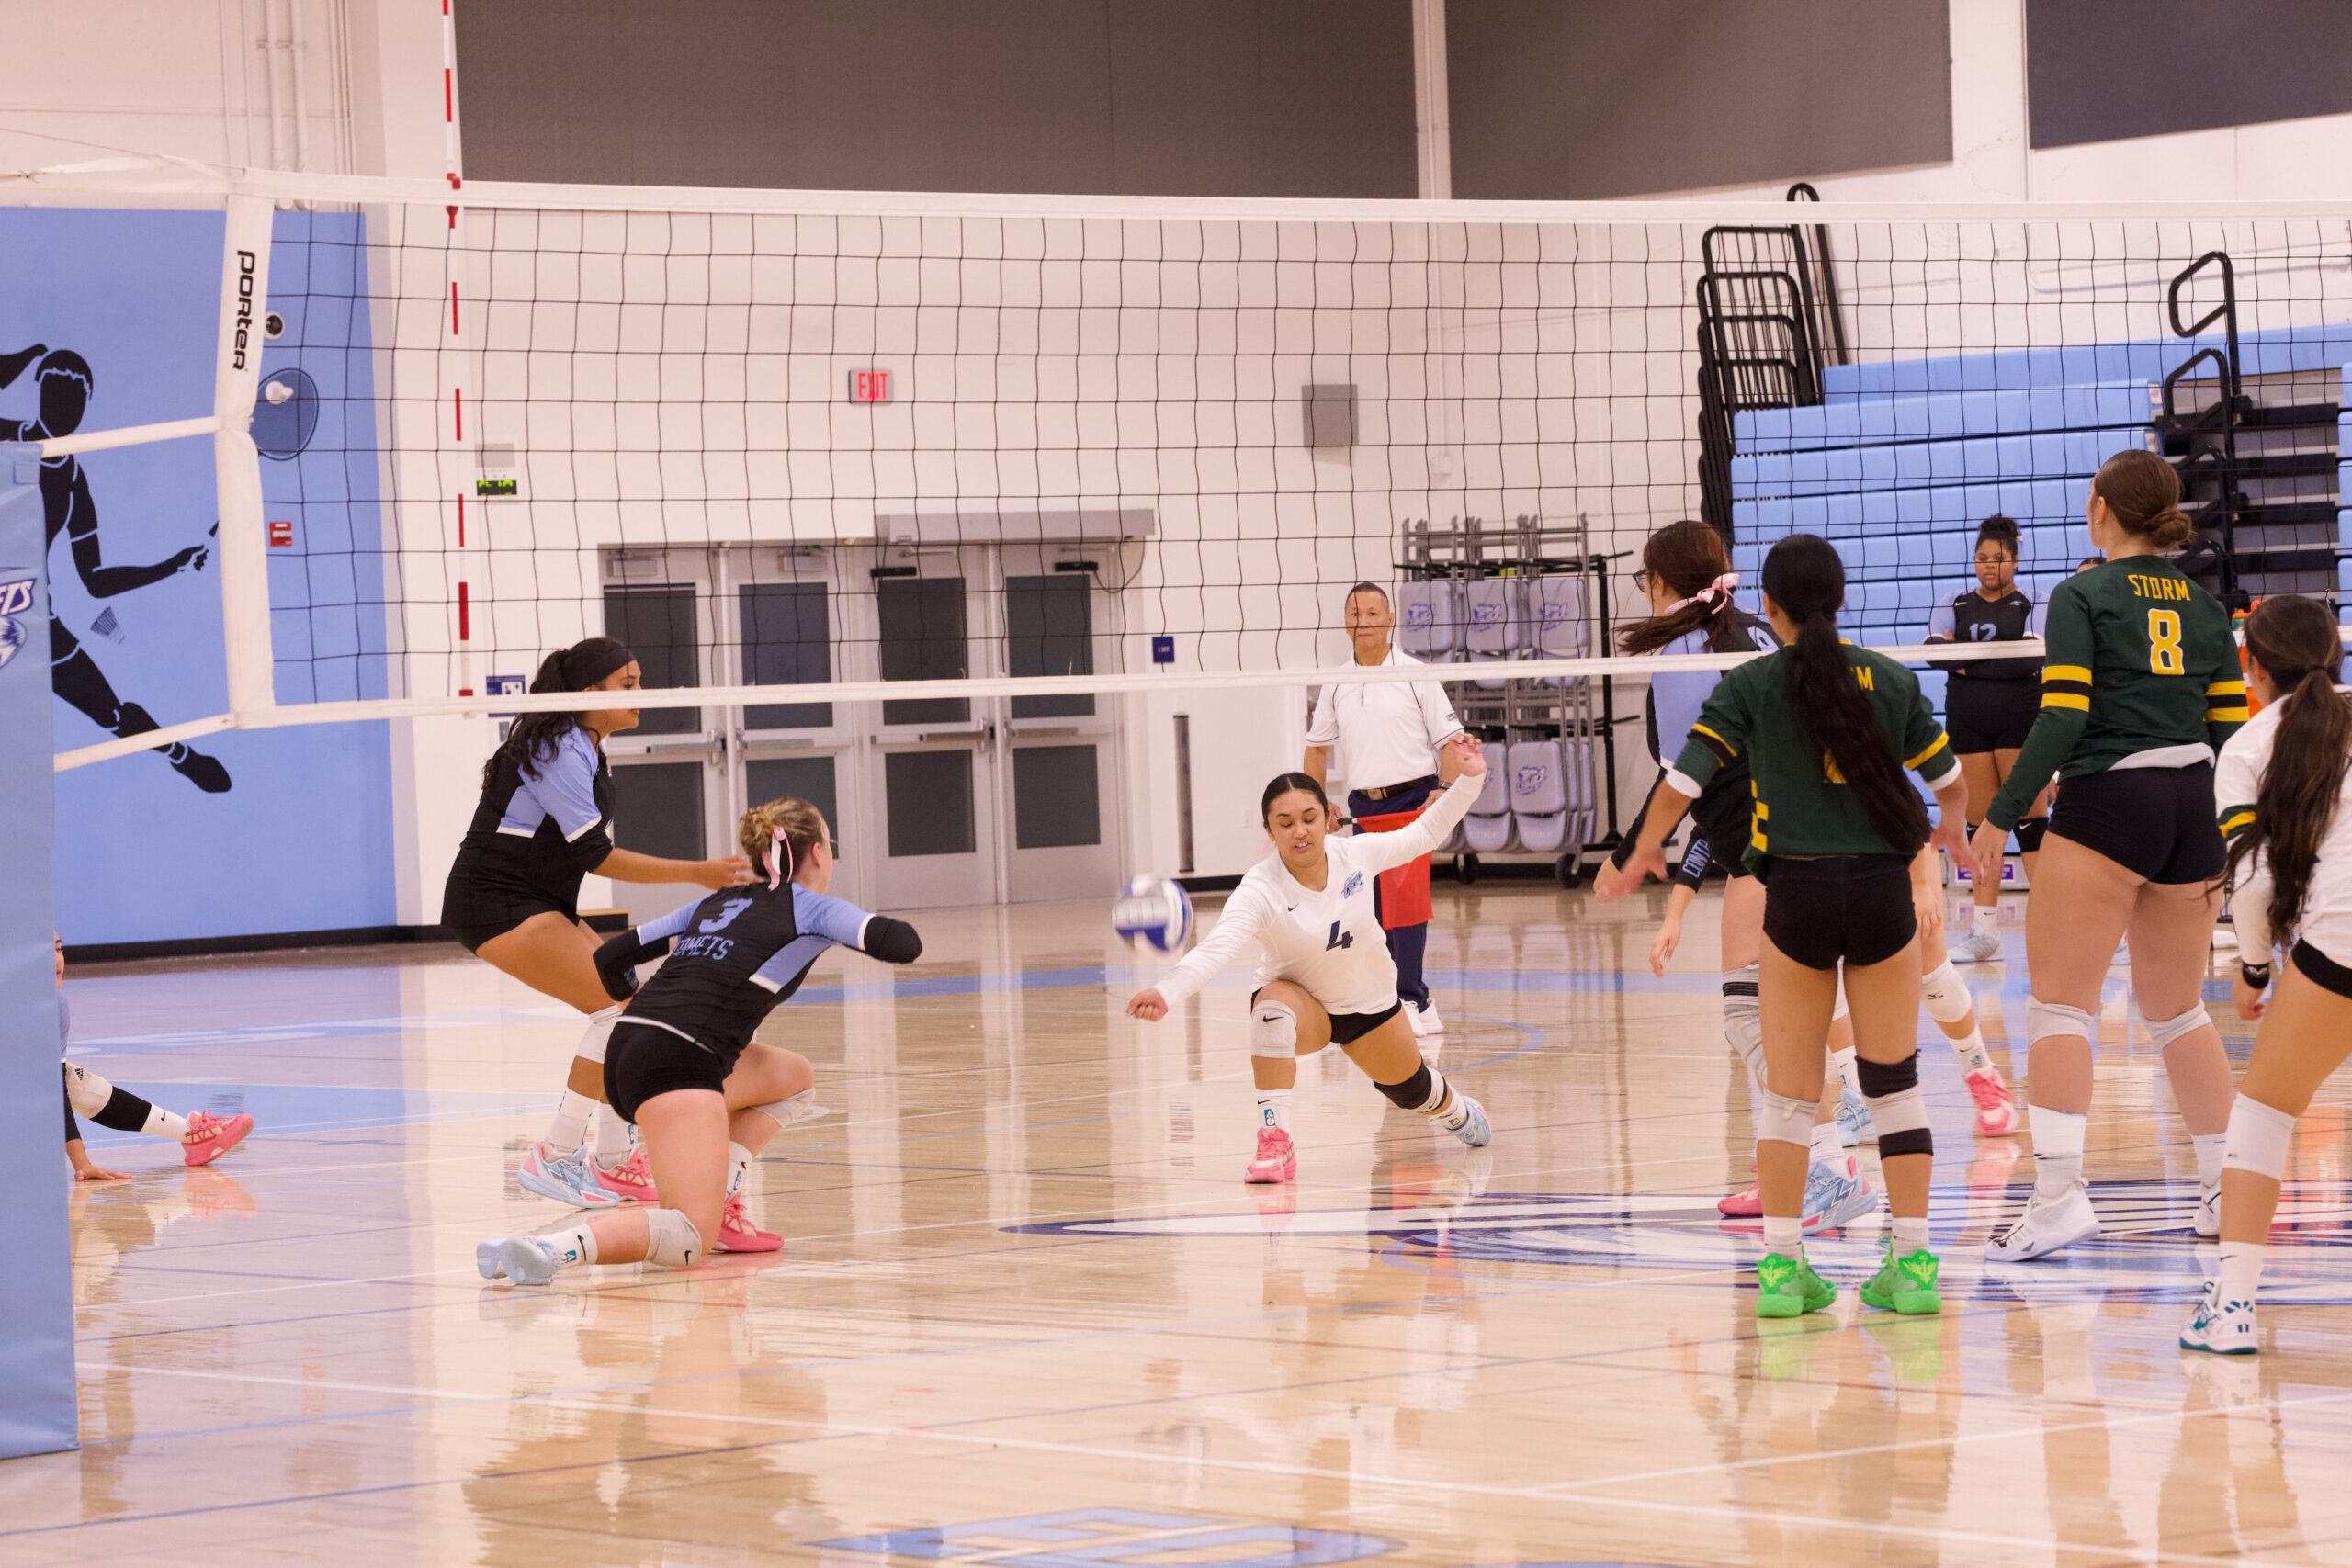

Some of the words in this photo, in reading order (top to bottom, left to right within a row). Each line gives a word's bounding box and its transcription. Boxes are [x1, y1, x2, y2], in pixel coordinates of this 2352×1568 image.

[858, 372, 888, 400] EXIT
[2127, 574, 2191, 602] STORM
[1969, 623, 1997, 642] 12
[2148, 608, 2185, 675] 8
[699, 898, 753, 934] 3
[1326, 920, 1353, 952] 4
